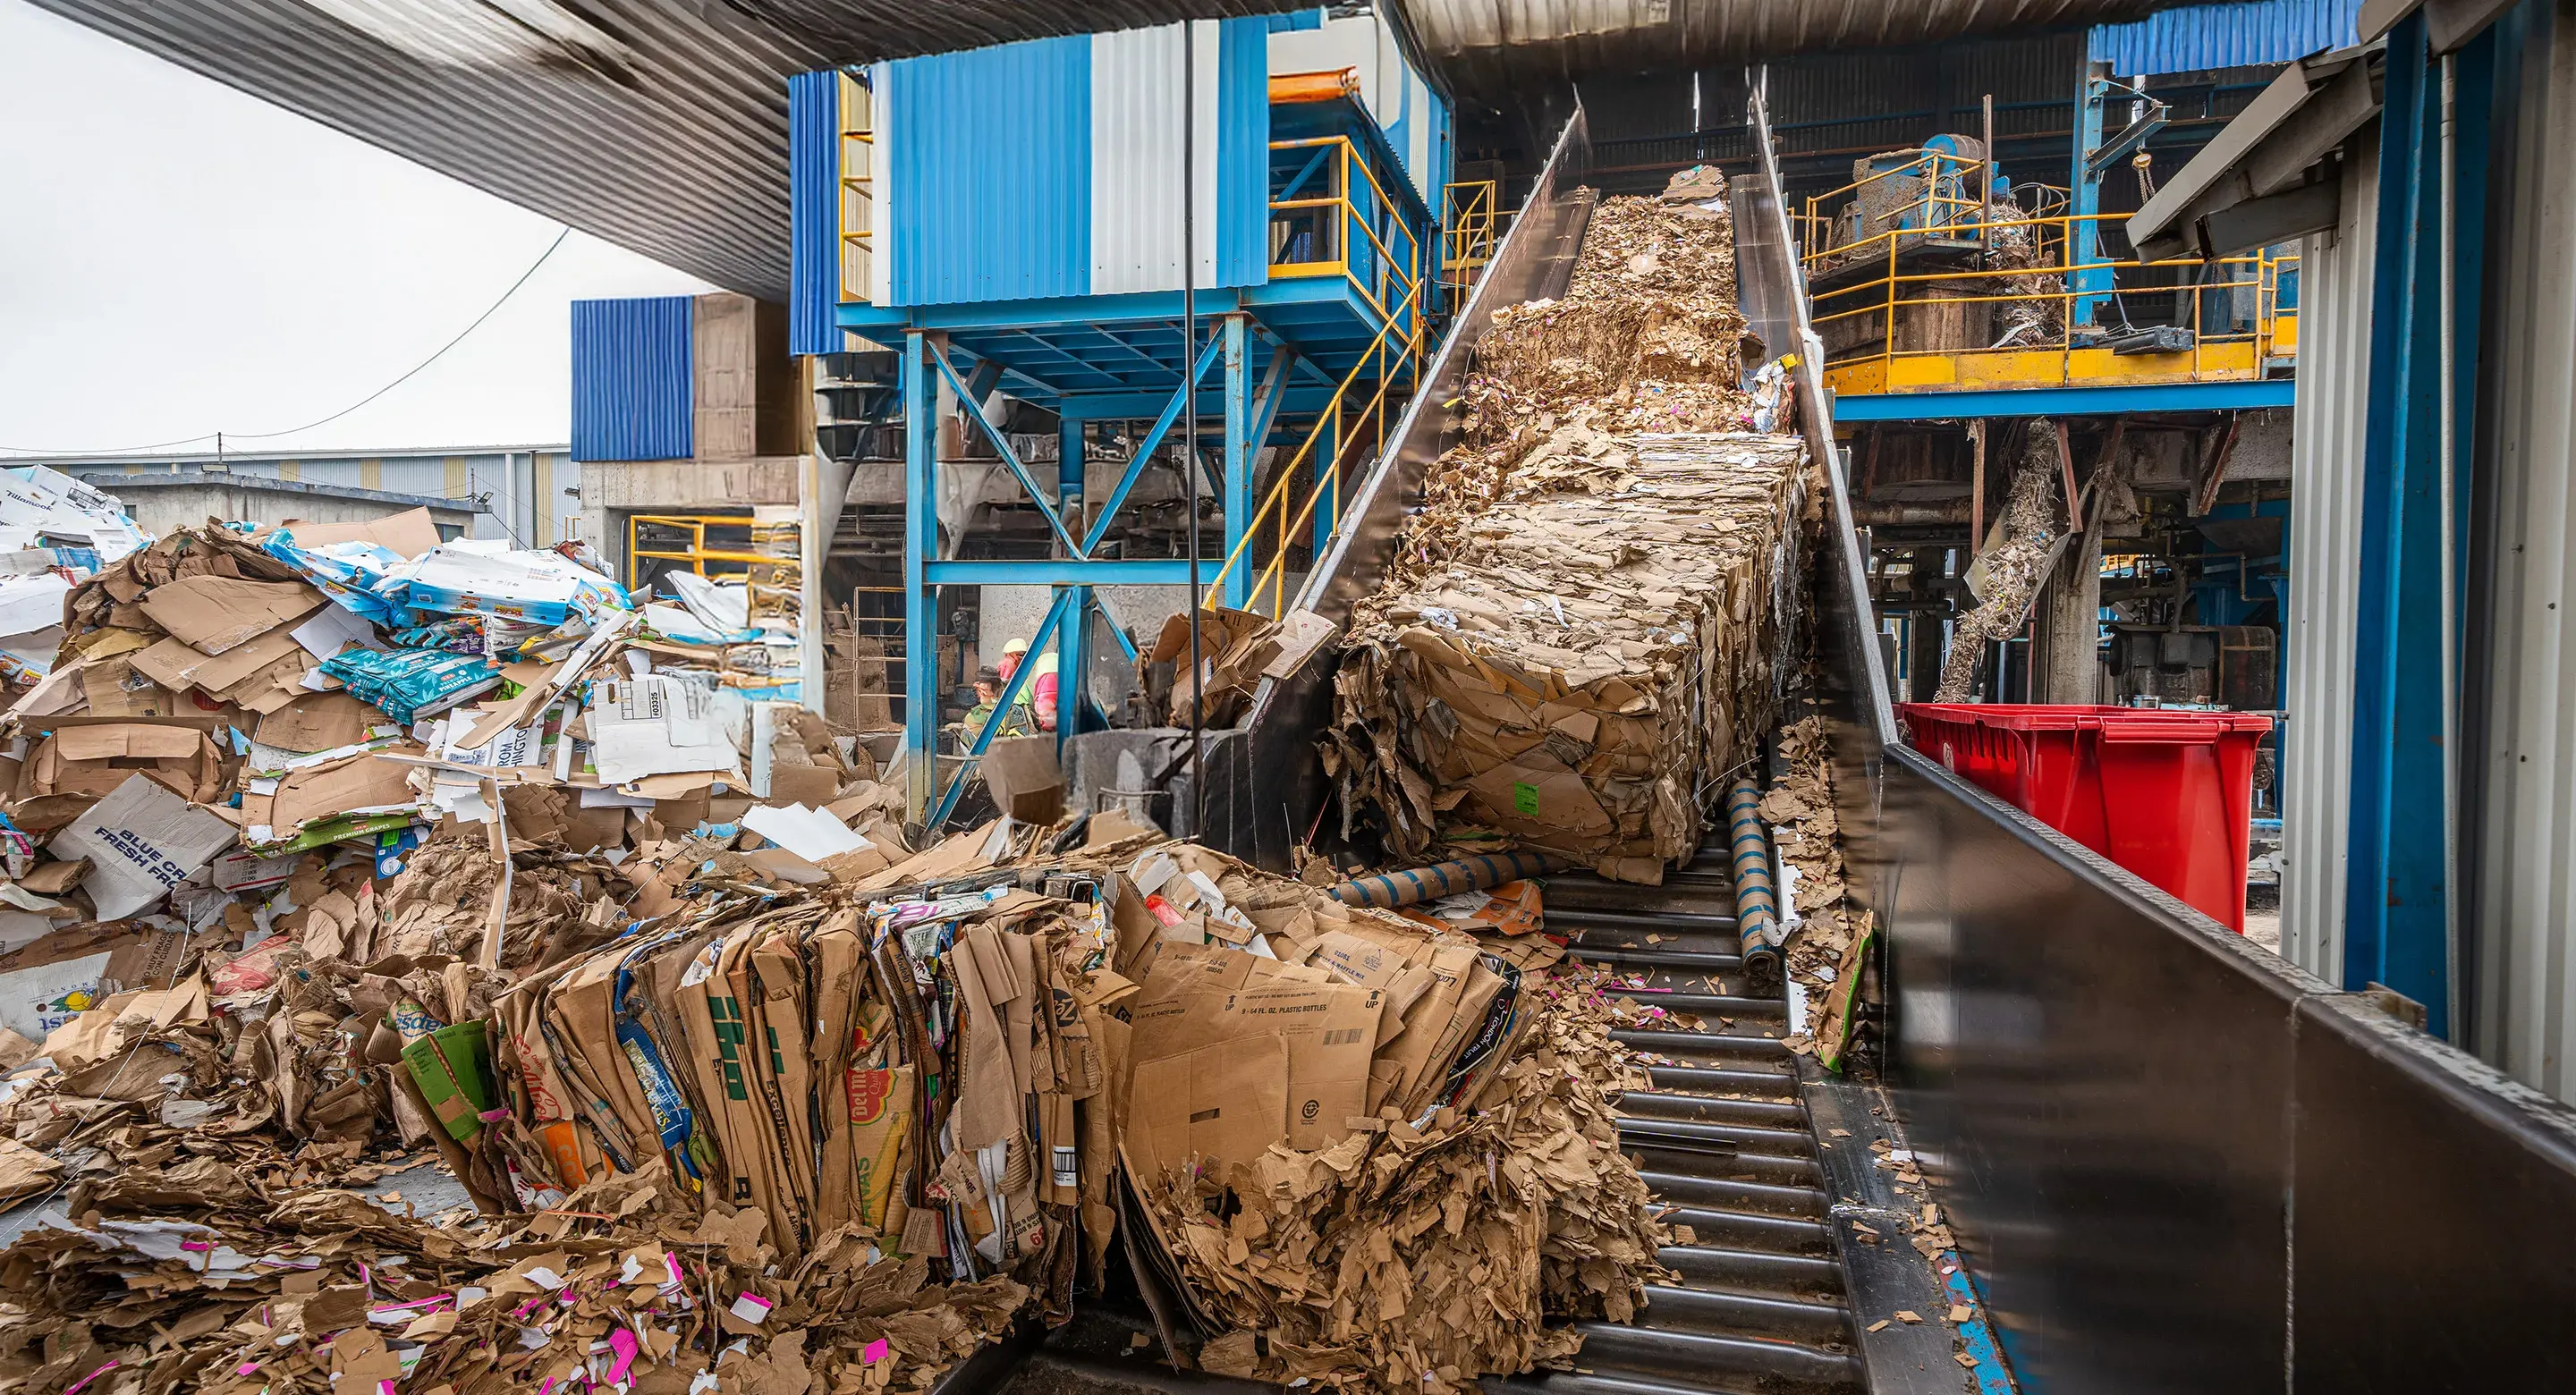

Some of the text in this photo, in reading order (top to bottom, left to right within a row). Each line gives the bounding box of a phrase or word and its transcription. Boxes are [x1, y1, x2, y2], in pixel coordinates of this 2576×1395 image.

[6, 490, 54, 512] Tillamook
[438, 676, 473, 693] PINEAPPLE
[333, 823, 391, 841] PREMIUM GRAPES
[94, 826, 148, 867] FRESH
[119, 829, 163, 862] BLUE
[153, 958, 164, 976] CON
[894, 952, 911, 983] Modelo
[1336, 963, 1356, 976] WAFFLE
[1355, 971, 1366, 980] MIX
[1224, 1003, 1235, 1011] UP
[1268, 1006, 1277, 1014] OZ.
[1278, 1005, 1301, 1014] PLASTIC
[1302, 1003, 1327, 1012] BOTTLES
[1365, 1001, 1378, 1009] UP
[1464, 1017, 1500, 1060] LONDON FRUIT
[852, 1093, 868, 1118] Del
